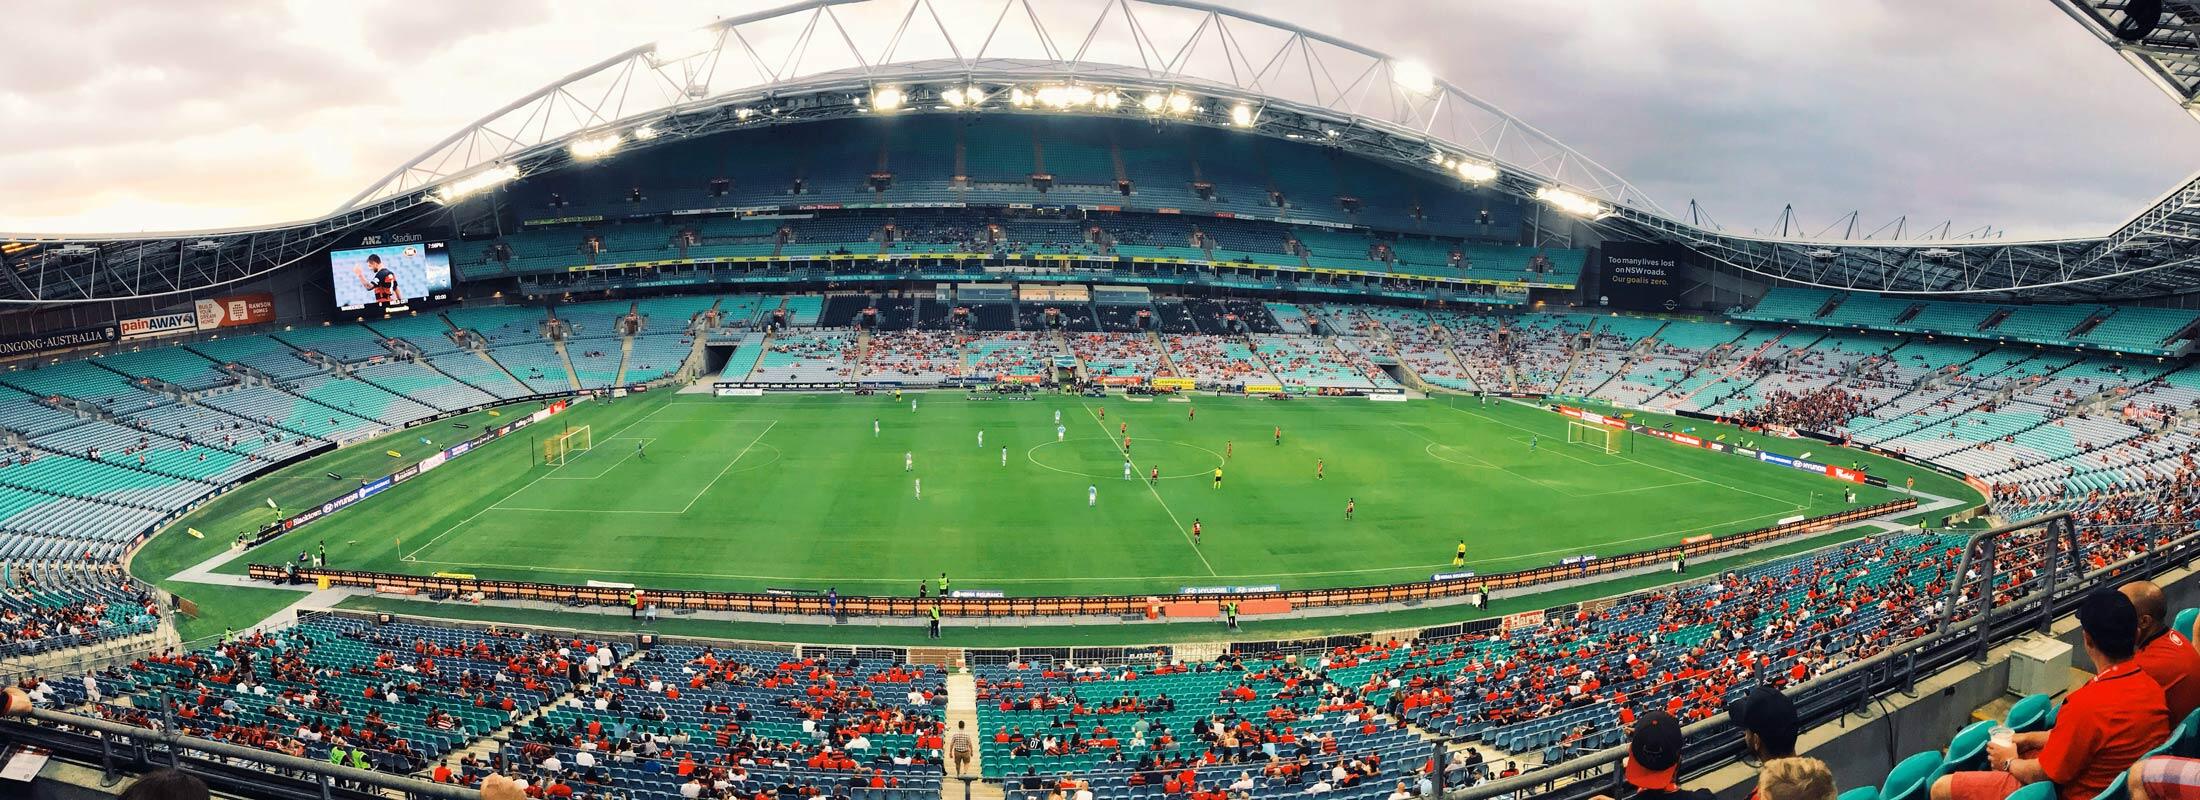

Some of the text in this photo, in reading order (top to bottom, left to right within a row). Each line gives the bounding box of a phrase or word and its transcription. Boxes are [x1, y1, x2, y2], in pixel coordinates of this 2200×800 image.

[361, 233, 422, 245] ANZ Stadium
[121, 317, 182, 334] painAWAY
[334, 492, 358, 508] HYUNDAI
[293, 510, 322, 526] Blacktown
